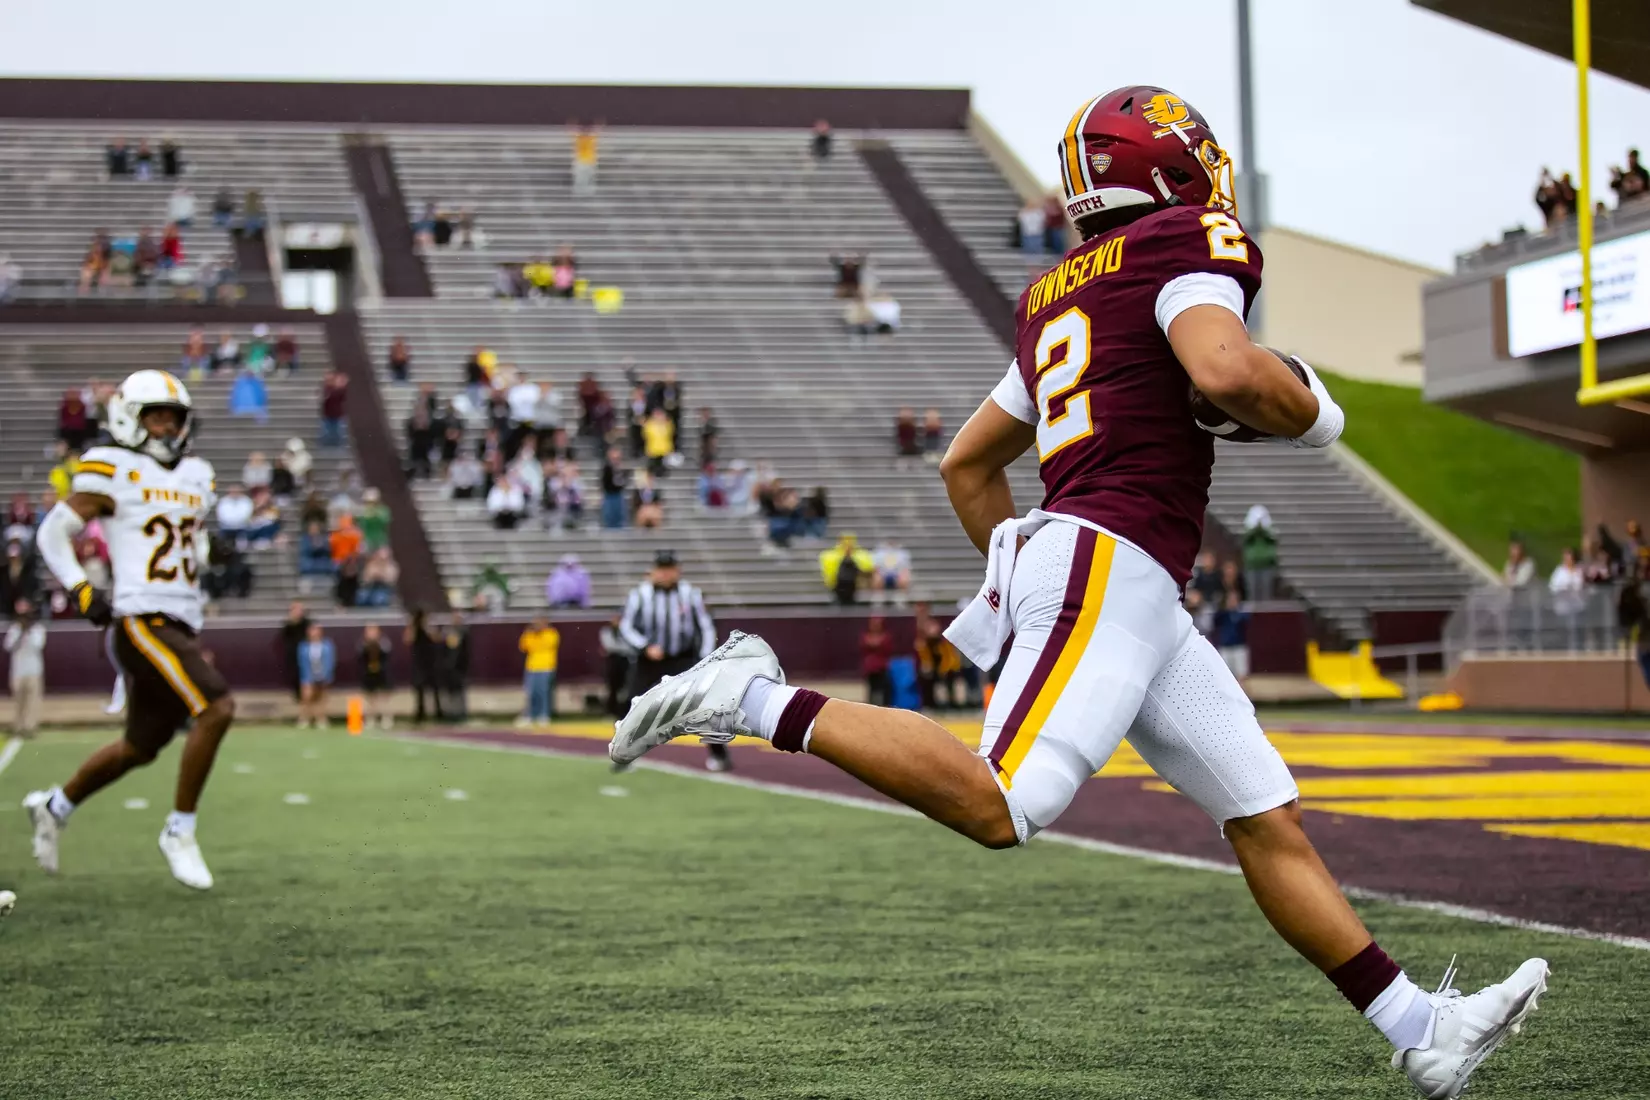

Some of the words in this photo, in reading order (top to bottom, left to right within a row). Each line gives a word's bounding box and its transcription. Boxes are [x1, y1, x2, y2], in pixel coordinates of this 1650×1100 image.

[1067, 195, 1106, 217] TRUTH
[1200, 212, 1248, 263] 2
[1026, 236, 1126, 320] TOWNSEND
[1035, 306, 1093, 463] 2
